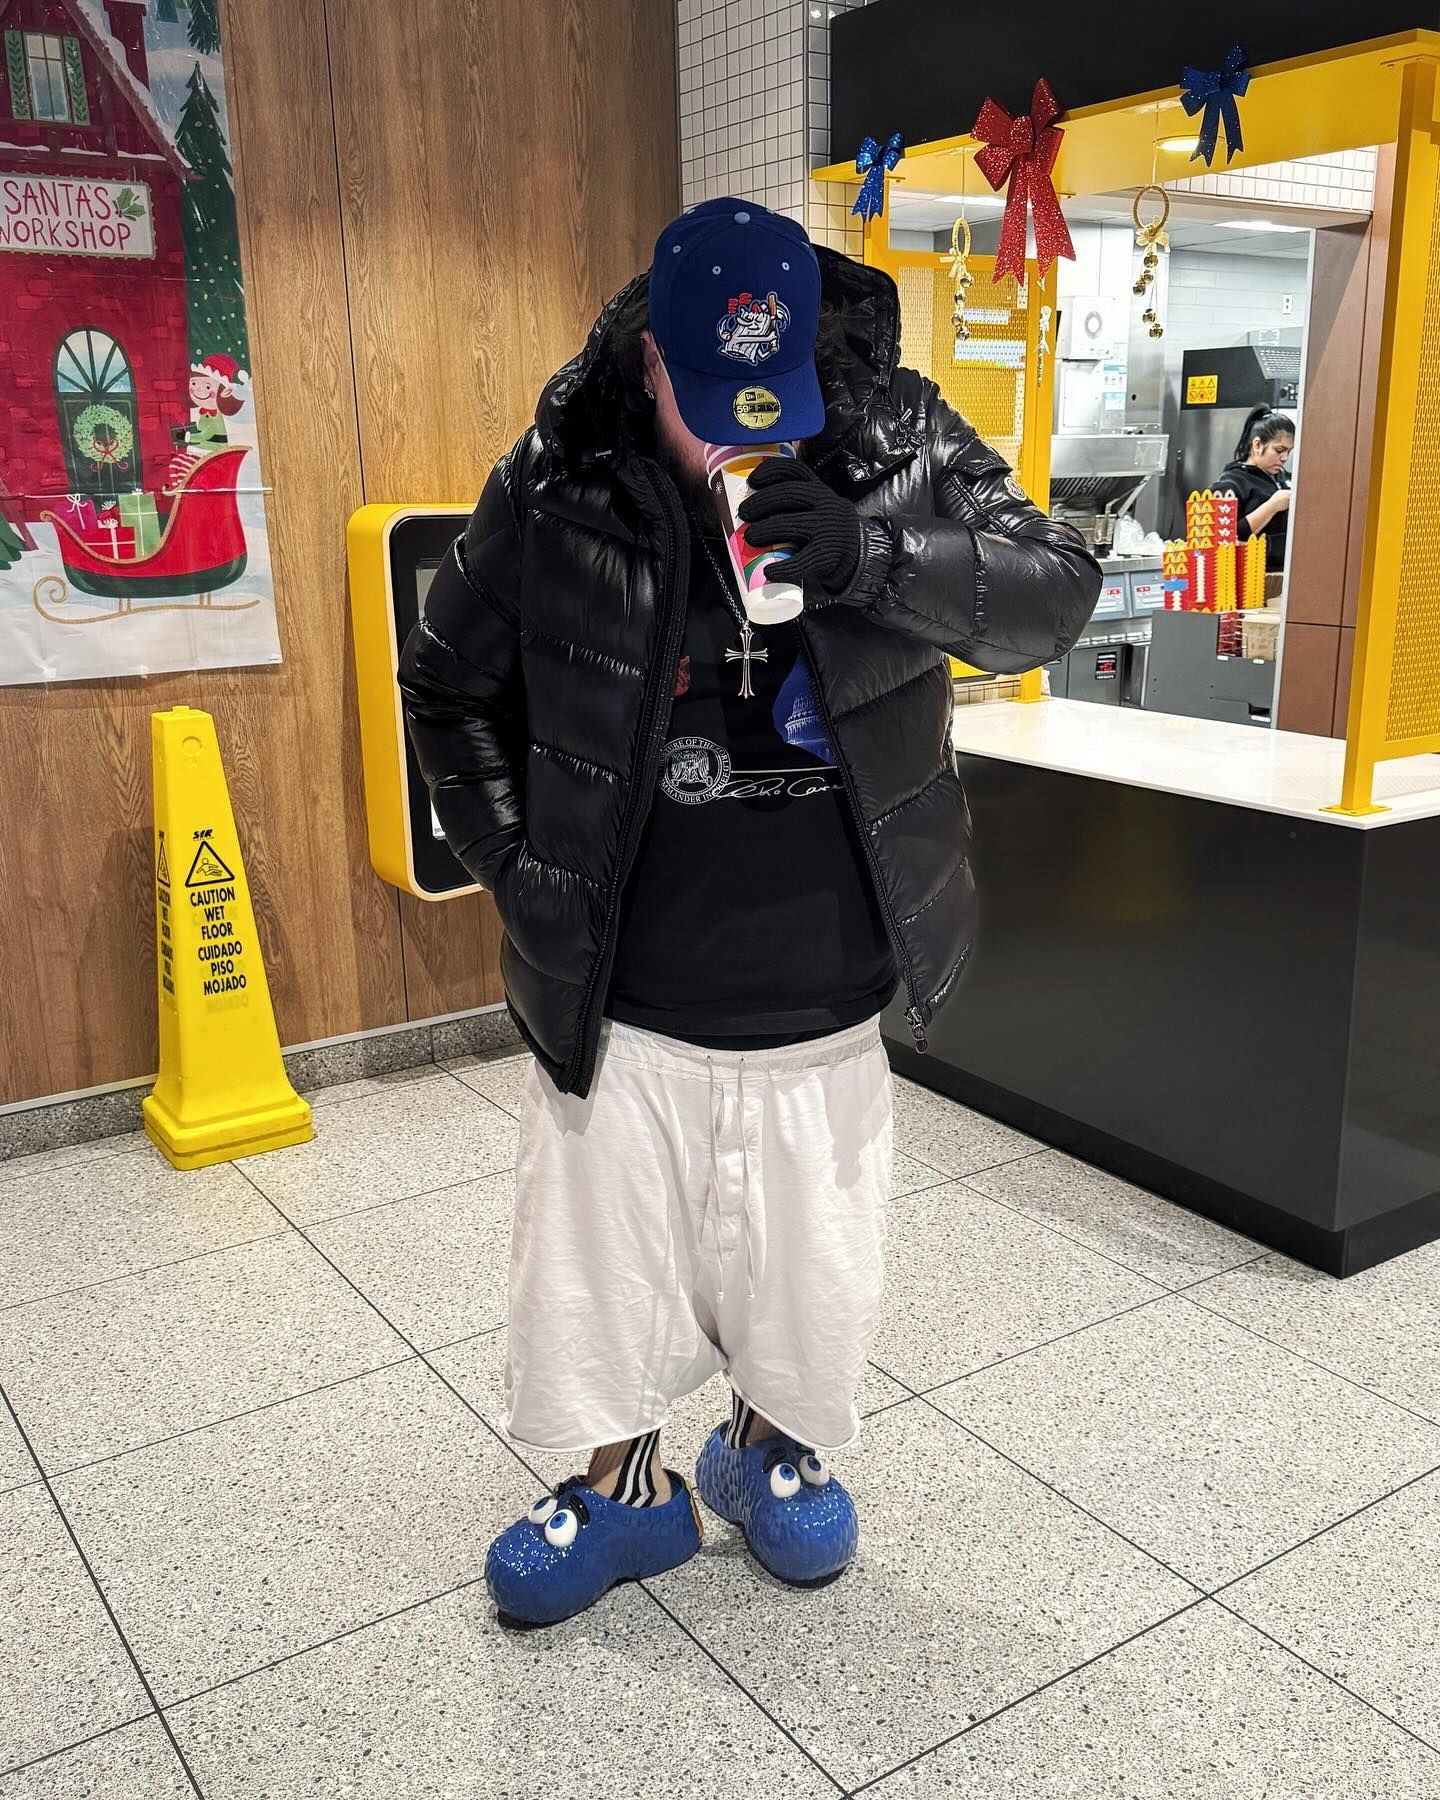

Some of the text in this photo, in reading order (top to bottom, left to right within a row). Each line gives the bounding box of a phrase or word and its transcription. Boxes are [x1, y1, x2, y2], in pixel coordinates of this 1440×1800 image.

[3, 180, 111, 220] SANTA'S
[699, 740, 714, 750] THE
[190, 887, 235, 906] CAUTION
[204, 905, 225, 922] WET
[201, 922, 234, 940] FLOOR
[198, 941, 242, 961] CUIDADO
[210, 960, 234, 977] PISO
[203, 975, 247, 996] MOJADO
